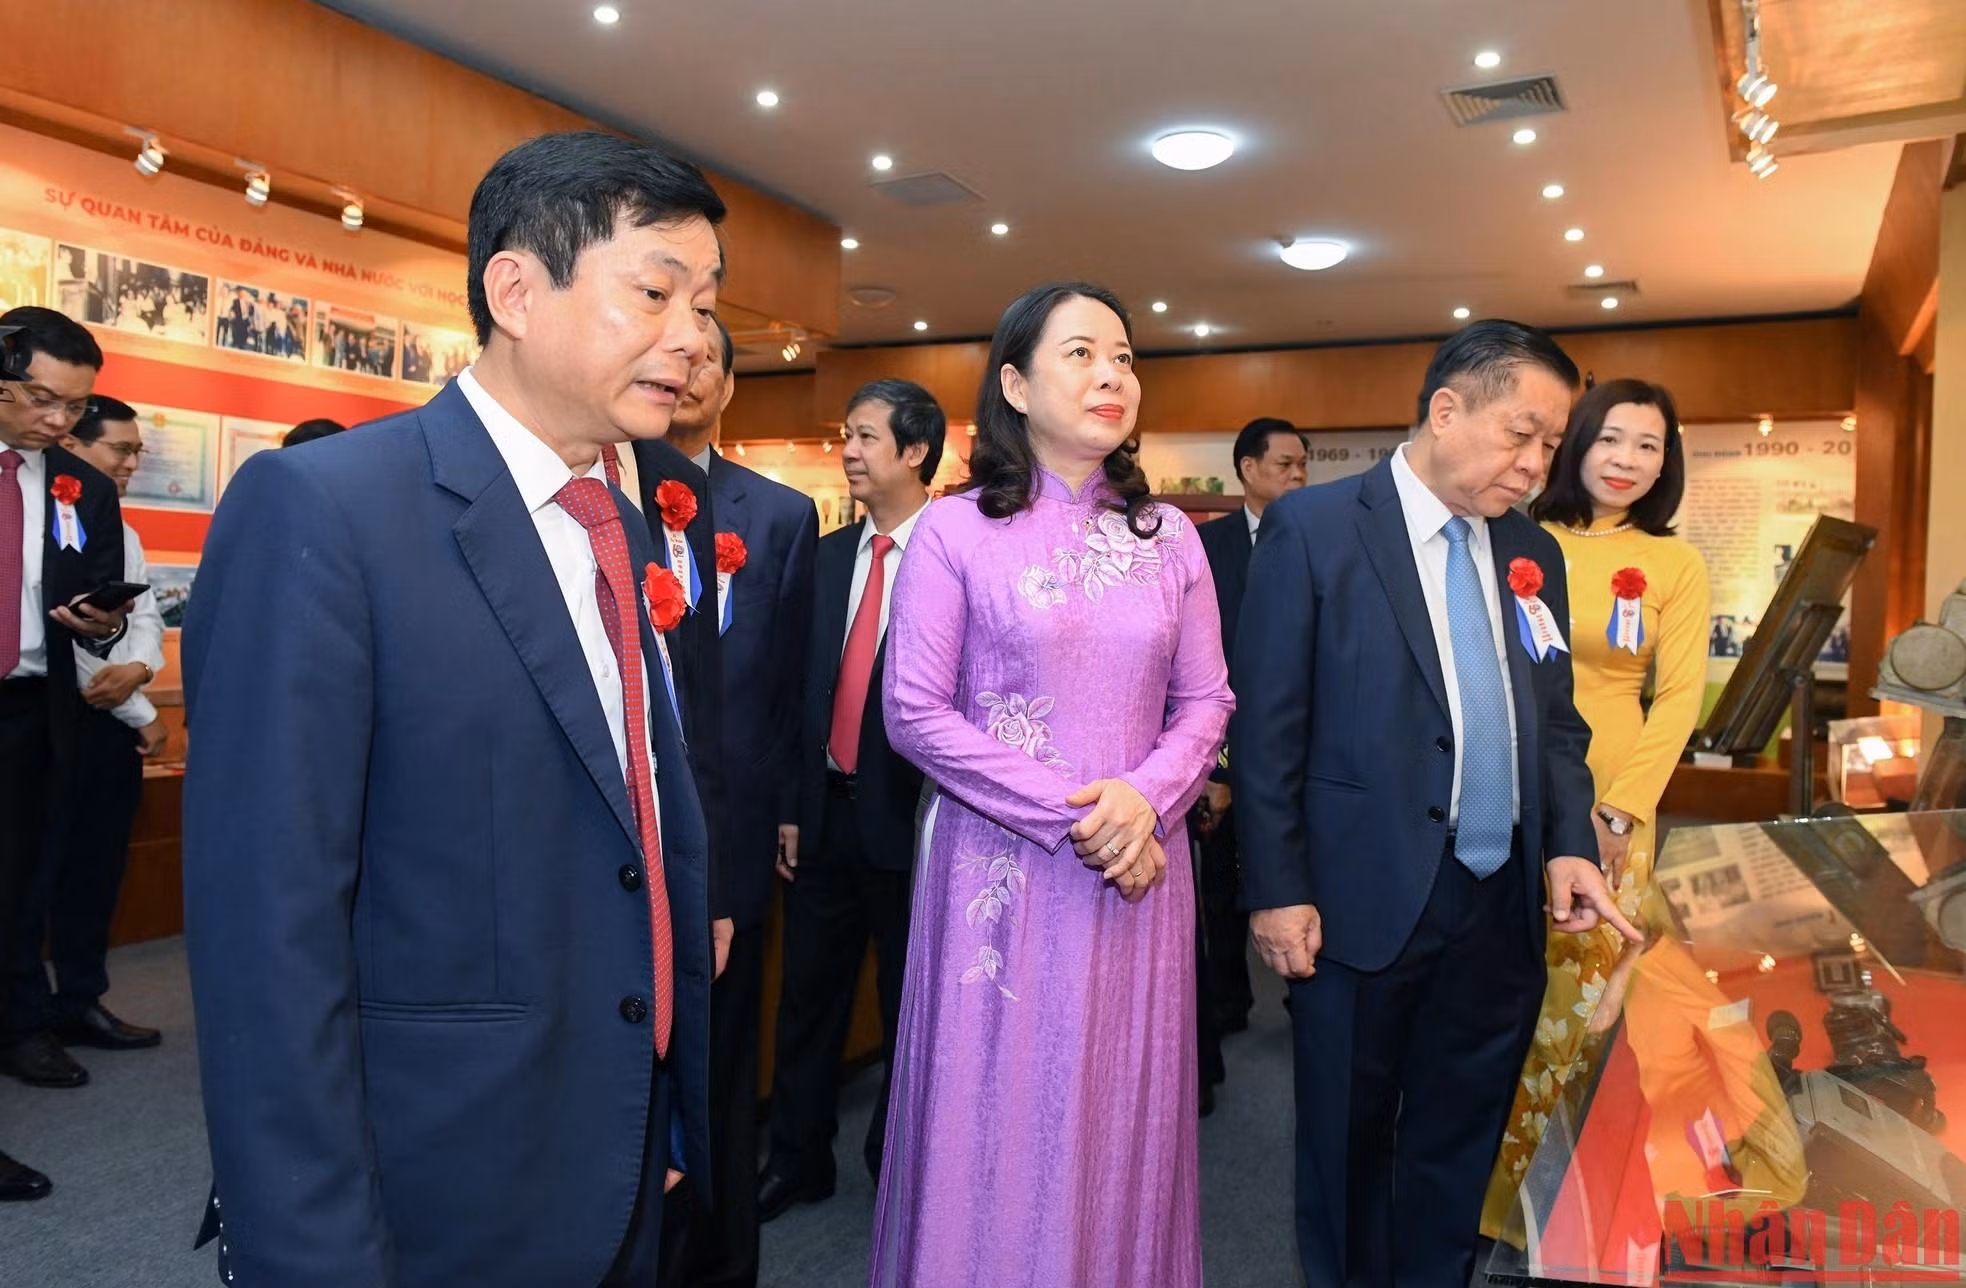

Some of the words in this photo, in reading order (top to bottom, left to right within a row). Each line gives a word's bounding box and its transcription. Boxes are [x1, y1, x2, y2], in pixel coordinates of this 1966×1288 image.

[45, 188, 76, 211] SỰ
[80, 197, 142, 225] QUAN
[147, 213, 190, 237] TÂM
[195, 225, 234, 249] CỦA
[239, 237, 290, 262] ĐẢNG
[294, 252, 318, 270] VÀ
[322, 259, 357, 280] NHÀ
[1309, 447, 1349, 461] 1969
[1744, 441, 1798, 457] 1990
[1823, 440, 1851, 456] 20
